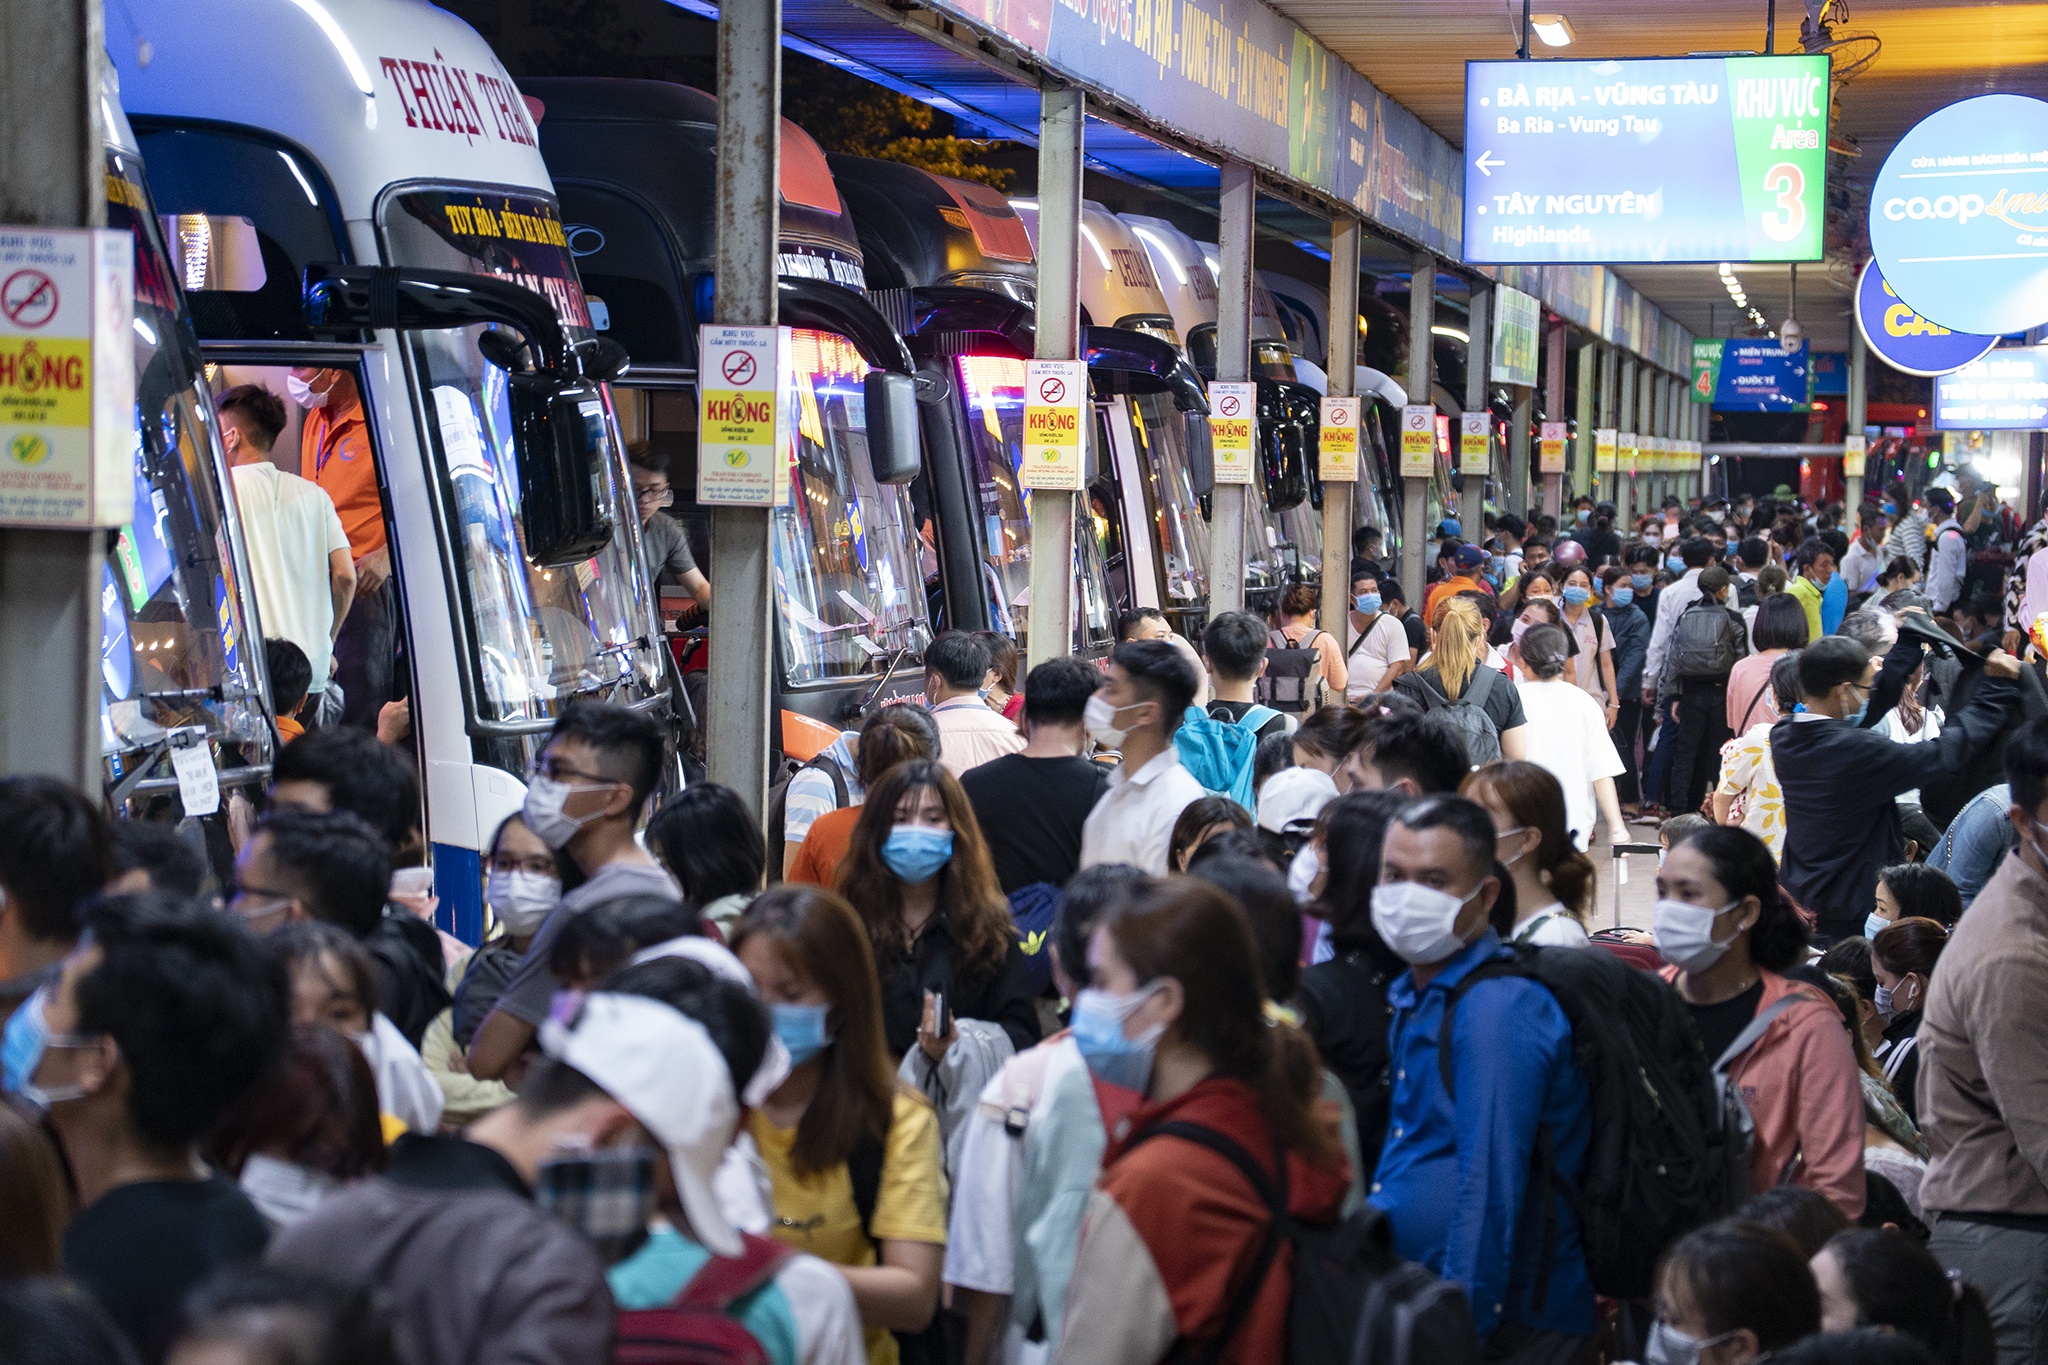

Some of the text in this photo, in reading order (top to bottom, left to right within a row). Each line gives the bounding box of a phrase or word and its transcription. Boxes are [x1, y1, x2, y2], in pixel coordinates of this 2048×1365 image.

[1211, 3, 1231, 100] TÀU
[1237, 21, 1255, 111] TÂY
[1254, 43, 1289, 129] NGUYÊN
[379, 46, 491, 147] THUẬN
[1497, 82, 1531, 107] BÀ
[1535, 86, 1577, 112] RỊA
[1594, 82, 1667, 106] VŨNG
[1669, 80, 1719, 105] TÀU
[1736, 72, 1822, 127] KHU VỰC
[1497, 116, 1520, 134] Ba
[1525, 116, 1554, 134] Ria
[1569, 115, 1619, 136] Vung
[1621, 115, 1658, 133] Tau
[1771, 123, 1819, 150] Area
[1494, 190, 1655, 215] TÂY NGUYÊN
[1761, 162, 1807, 242] 3
[1883, 193, 1985, 225] co.op
[445, 205, 475, 235] TUY
[472, 197, 501, 237] HÒA
[1492, 225, 1591, 247] Highlands
[1696, 370, 1712, 397] 4
[707, 392, 771, 424] KHÔNG
[1029, 407, 1075, 431] KHÔNG
[1212, 420, 1248, 438] KHÔNG
[1323, 428, 1354, 443] KHÔNG
